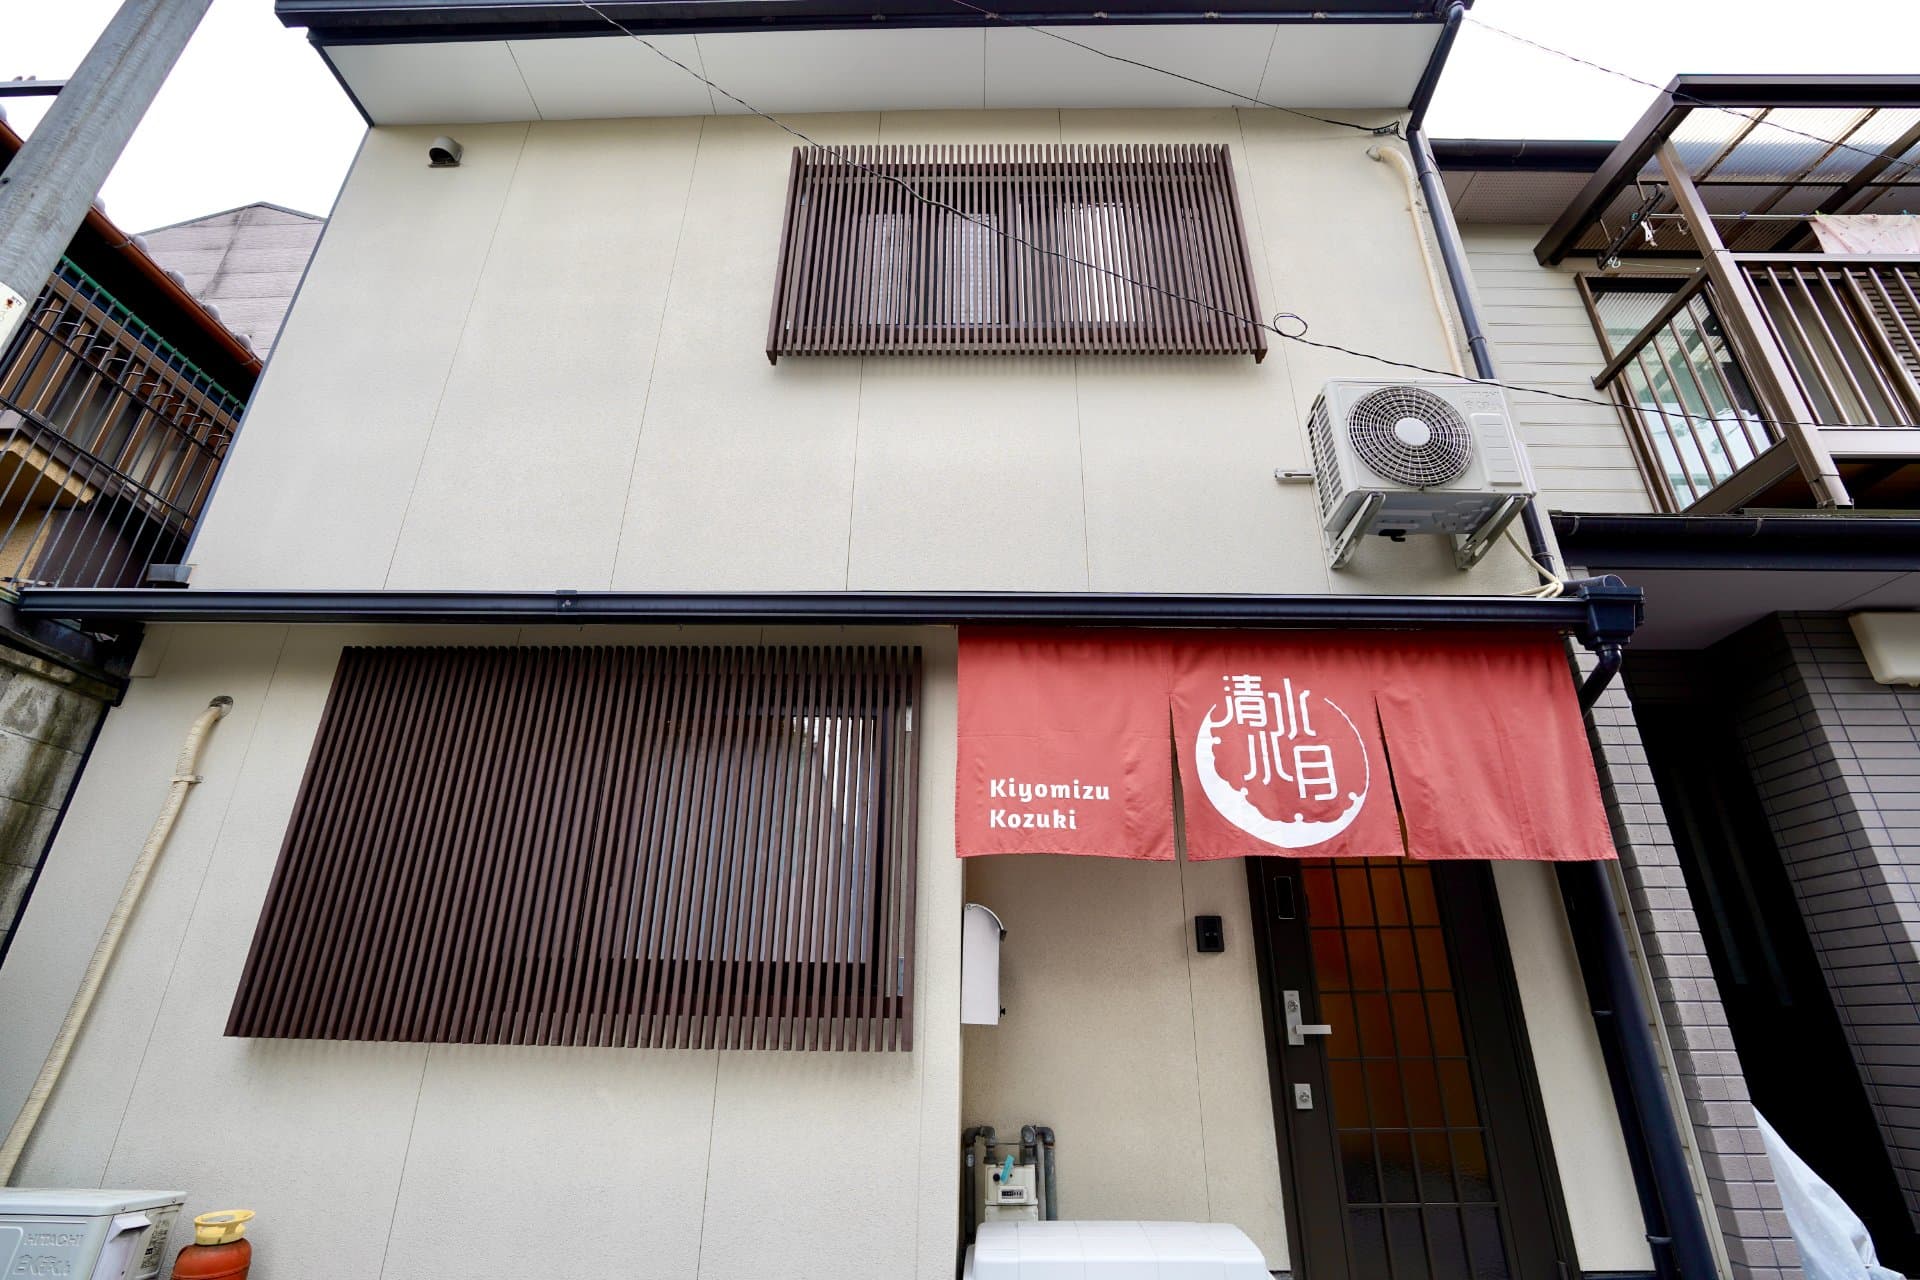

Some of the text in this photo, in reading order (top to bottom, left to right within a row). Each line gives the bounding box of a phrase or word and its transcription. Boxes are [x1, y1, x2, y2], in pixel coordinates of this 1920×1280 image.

[1211, 674, 1316, 741] 清水
[990, 777, 1110, 802] Kiyomizu
[990, 809, 1076, 829] Kozuki
